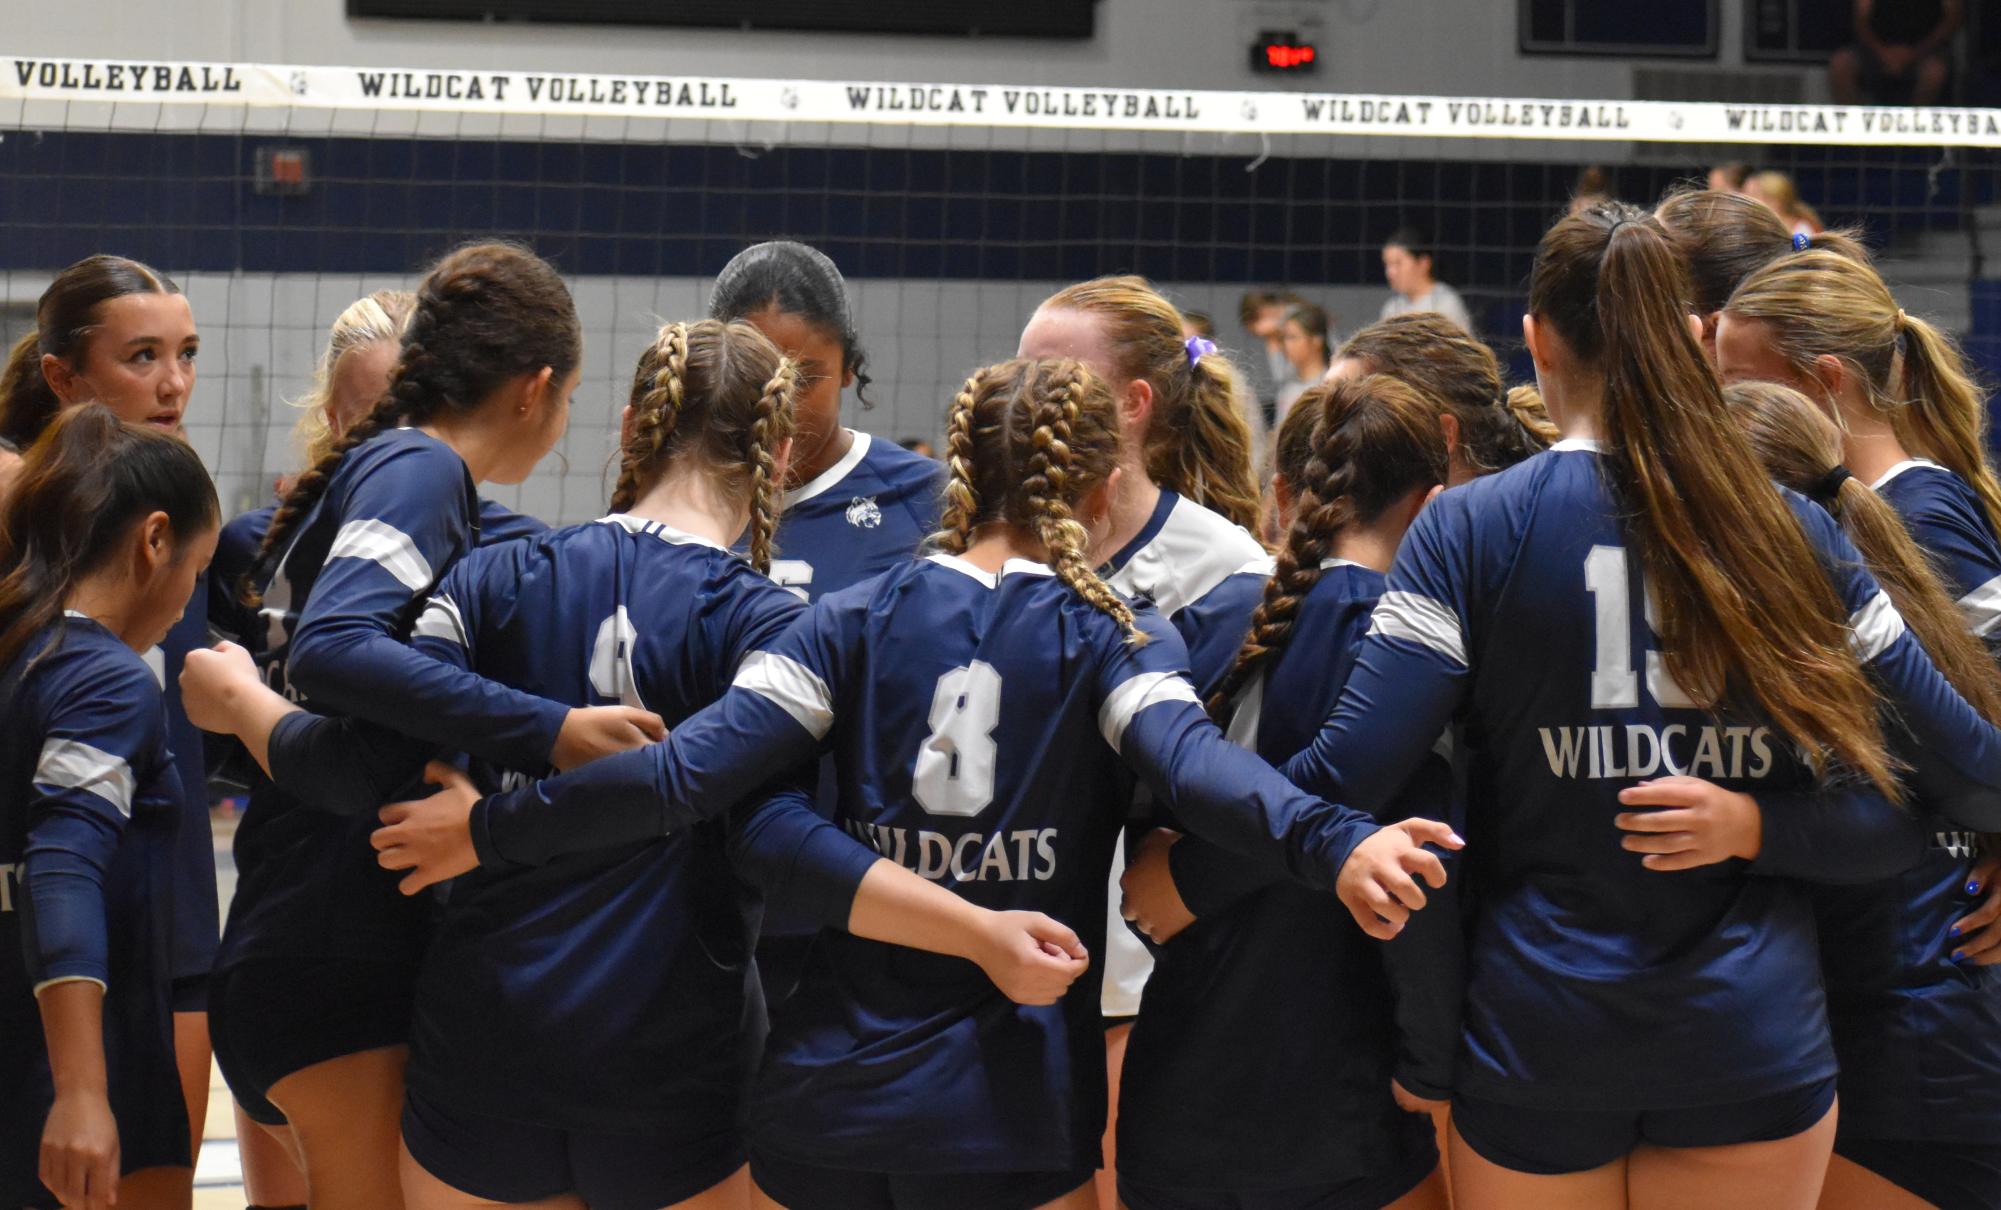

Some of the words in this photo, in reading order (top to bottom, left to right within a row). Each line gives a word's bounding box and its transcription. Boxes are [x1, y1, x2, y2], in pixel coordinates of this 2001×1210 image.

[15, 60, 242, 92] VOLLEYBALL
[358, 72, 510, 101] WILDCAT
[526, 76, 738, 108] VOLLEYBALL
[846, 86, 988, 113] WILDCAT
[1003, 90, 1200, 119] VOLLEYBALL
[1302, 98, 1432, 125] WILDCAT
[1448, 102, 1630, 130] VOLLEYBALL
[1725, 108, 1848, 133] WILDCAT
[912, 658, 1002, 817] 8
[1537, 723, 1774, 780] WILDCATS
